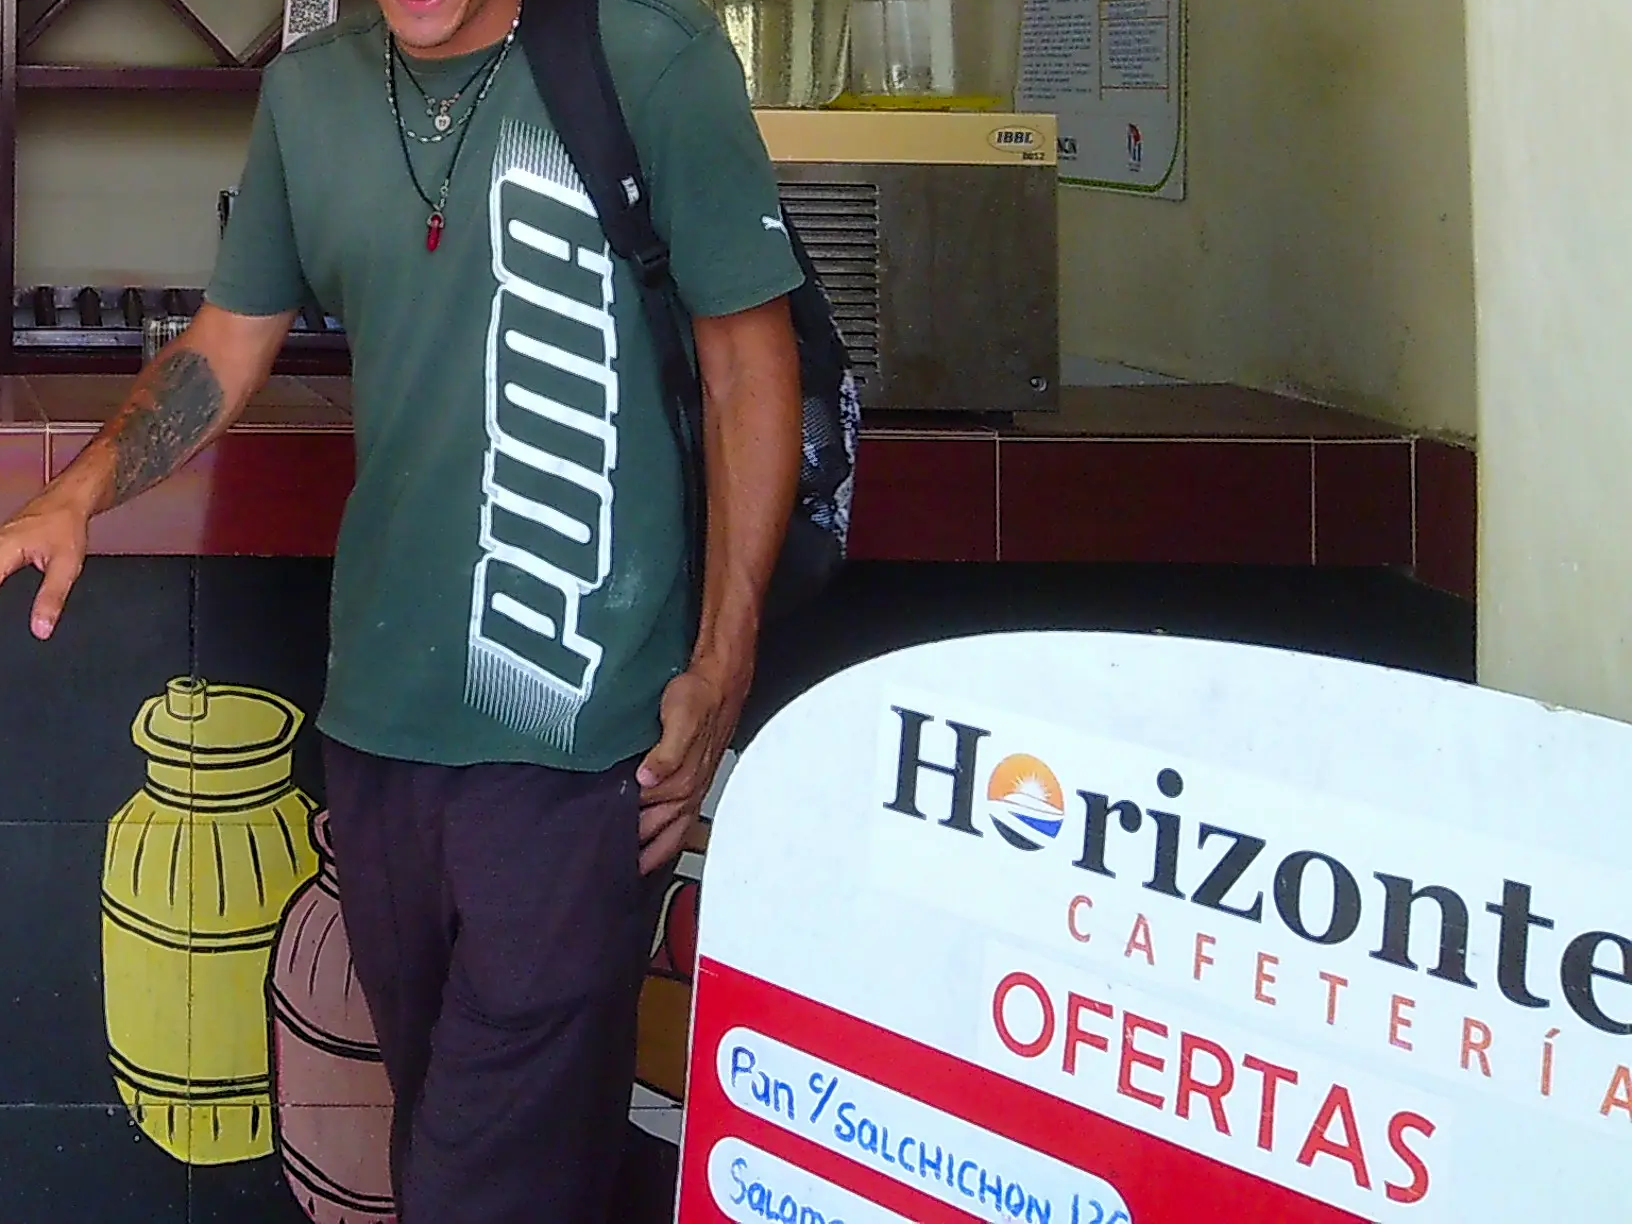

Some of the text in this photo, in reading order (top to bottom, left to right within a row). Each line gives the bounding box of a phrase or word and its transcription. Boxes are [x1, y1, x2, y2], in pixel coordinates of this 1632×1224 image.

[996, 131, 1034, 144] IBBL
[471, 172, 618, 698] PUMA
[882, 704, 1632, 1036] Horizonte
[731, 1046, 795, 1120] Pan
[992, 971, 1437, 1204] OFERTAS
[1068, 894, 1632, 1125] CAFETERÍA
